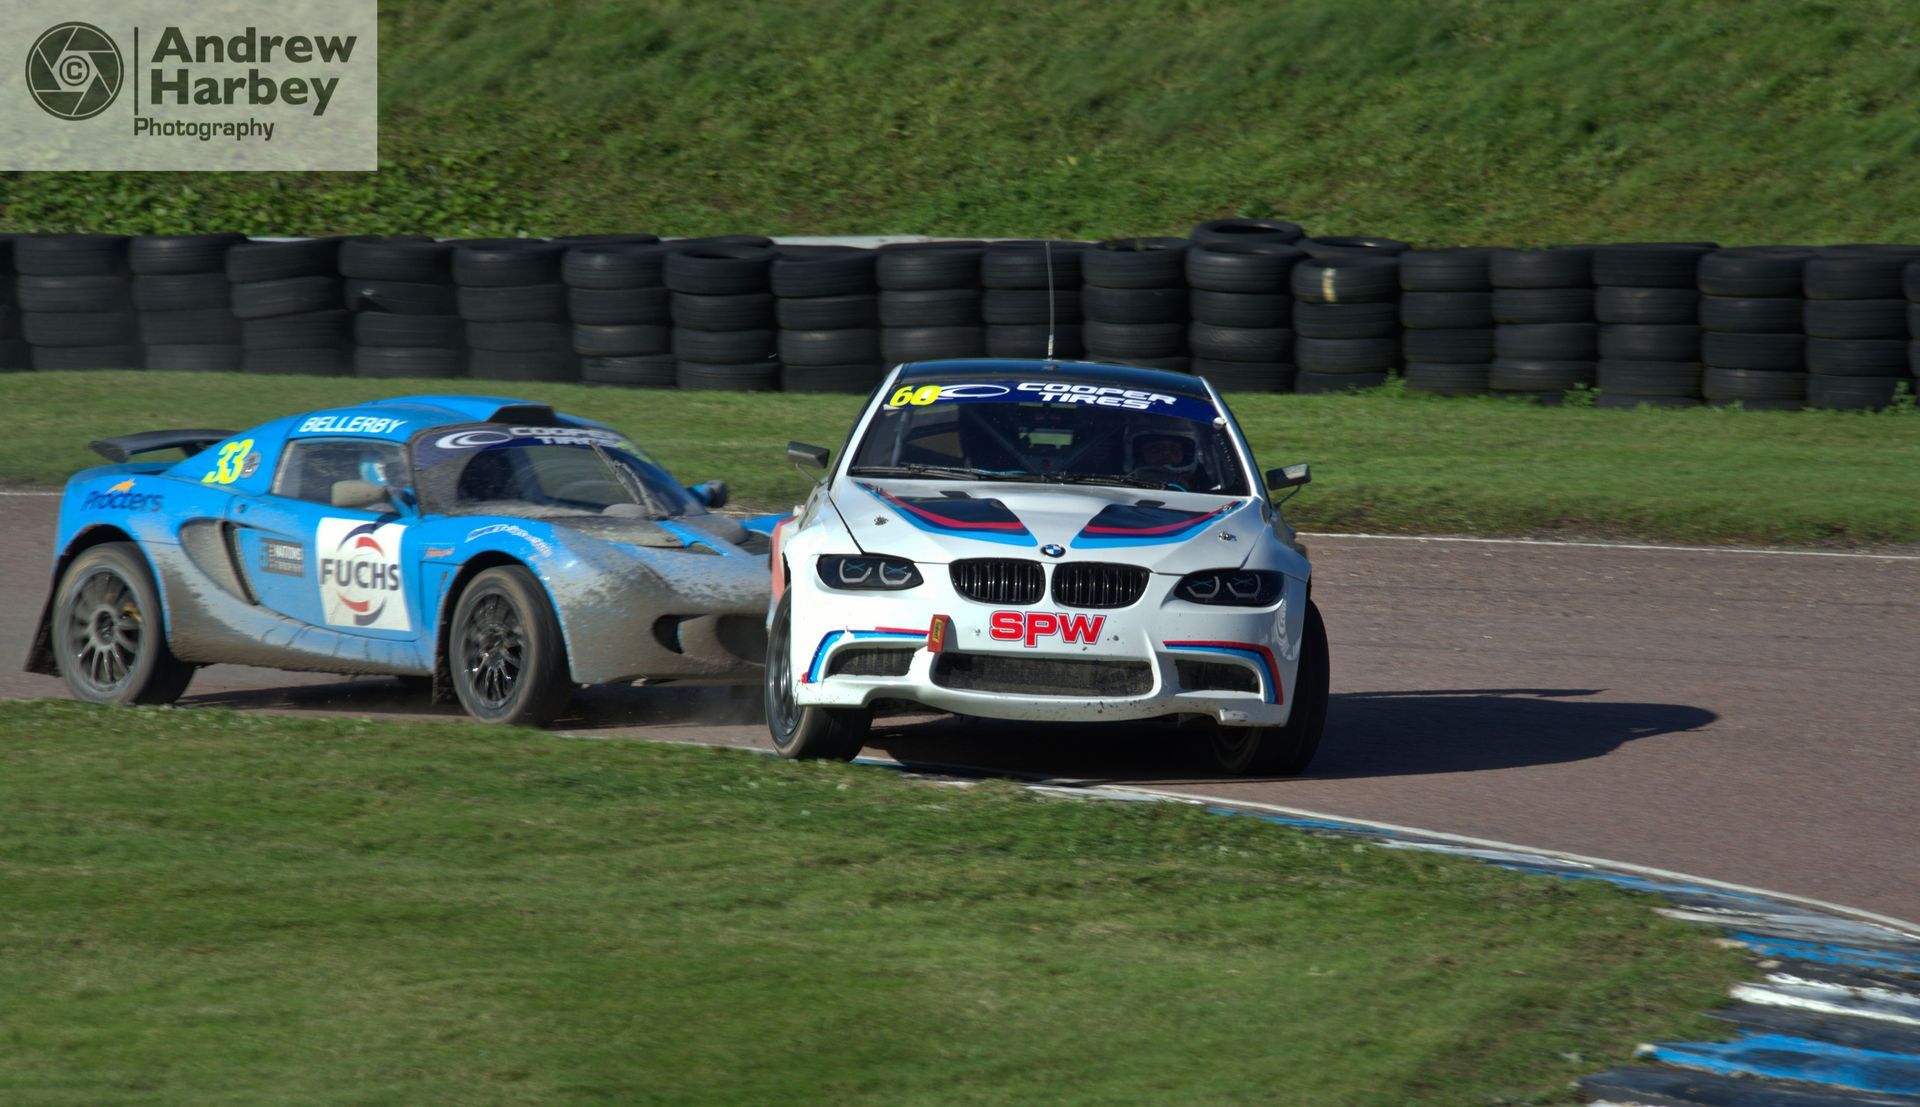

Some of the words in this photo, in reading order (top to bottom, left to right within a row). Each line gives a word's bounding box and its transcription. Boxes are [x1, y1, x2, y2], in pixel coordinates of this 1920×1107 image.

[889, 385, 942, 407] 60
[1017, 382, 1177, 405] COOPER
[1038, 392, 1152, 410] TIRES
[298, 415, 409, 434] BELLERBY
[201, 439, 255, 484] 33
[80, 489, 164, 512] Procters
[319, 557, 400, 591] FUCHS
[988, 610, 1107, 648] SPW
